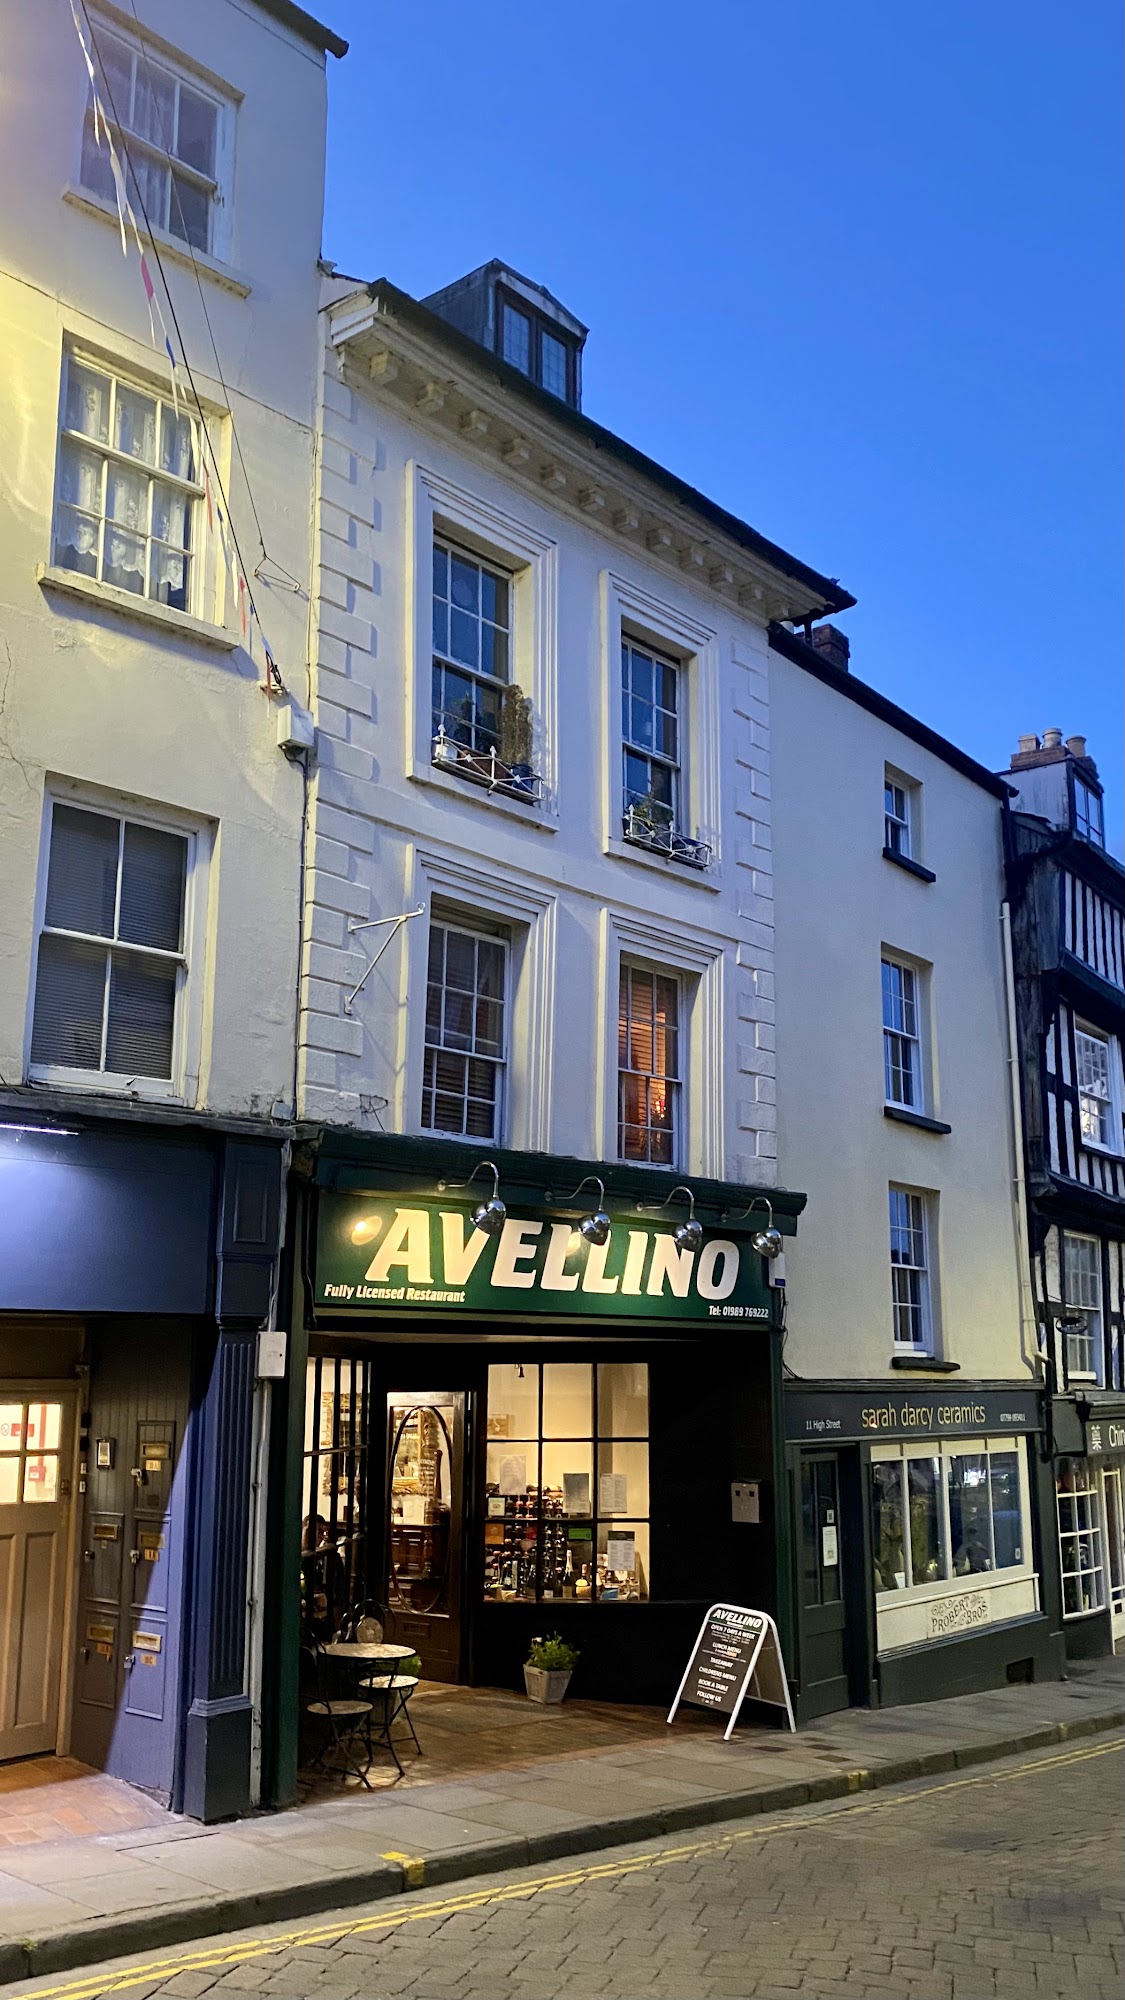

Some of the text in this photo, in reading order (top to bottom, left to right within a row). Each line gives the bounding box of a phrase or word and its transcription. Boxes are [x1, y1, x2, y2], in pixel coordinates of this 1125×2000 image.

[364, 1208, 740, 1300] AVELLINO
[324, 1284, 466, 1303] Fully Licensed Restaurant
[709, 1305, 769, 1318] Tel: 01989 769222
[805, 1419, 841, 1432] 11 High Street
[862, 1401, 986, 1431] sarah darcy ceramics
[712, 1609, 763, 1628] AVELLINO
[931, 1596, 970, 1632] PROBERT
[711, 1624, 724, 1632] OPEN
[722, 1672, 737, 1681] MENU
